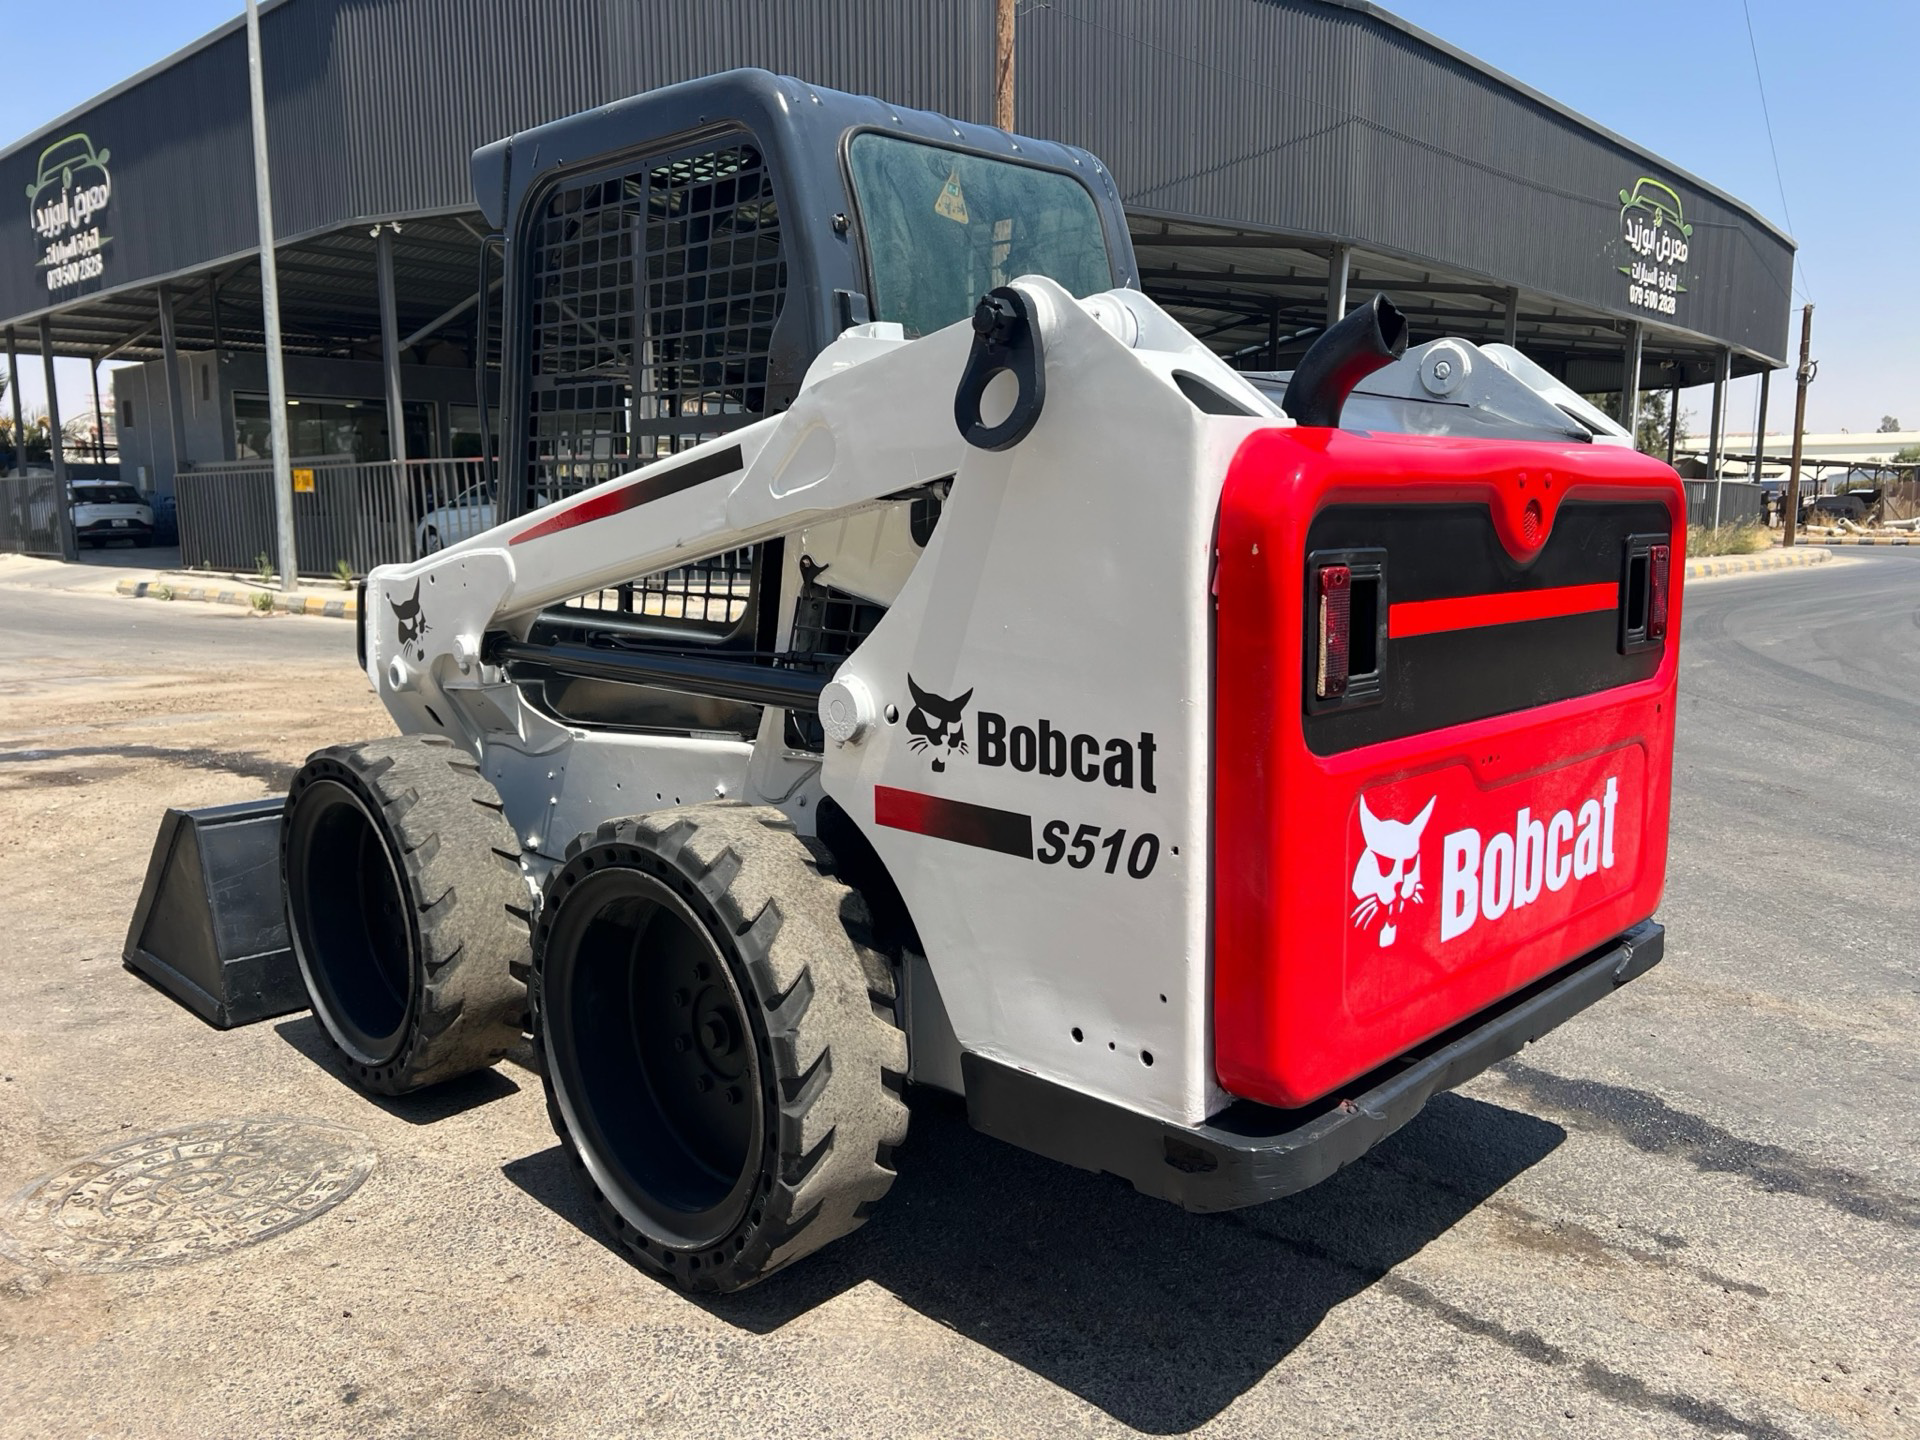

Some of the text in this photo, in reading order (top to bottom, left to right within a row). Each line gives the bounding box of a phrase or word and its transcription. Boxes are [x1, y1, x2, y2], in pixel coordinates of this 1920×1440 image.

[69, 185, 107, 229] معرض
[45, 235, 77, 265] السيارات
[1656, 230, 1688, 266] معرض
[1631, 262, 1678, 294] لتجارة السيارات
[1629, 284, 1676, 315] 079 500 2828
[977, 711, 1157, 794] Bobcat
[1037, 819, 1160, 879] S510
[1440, 776, 1619, 943] Bobcat
